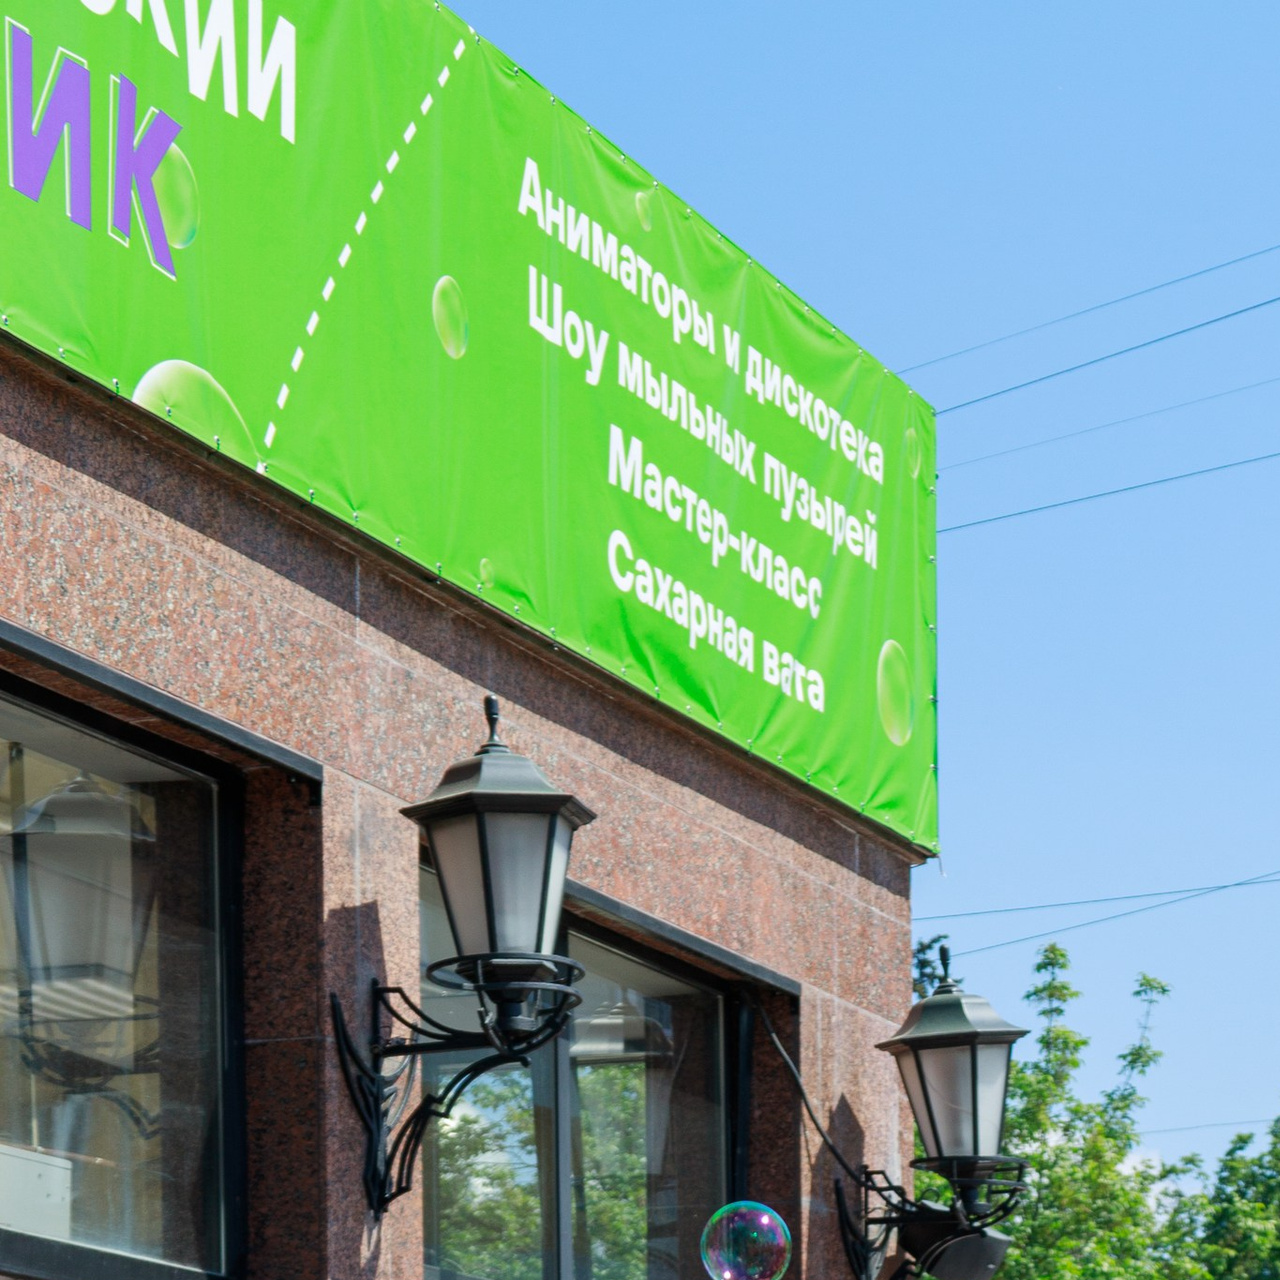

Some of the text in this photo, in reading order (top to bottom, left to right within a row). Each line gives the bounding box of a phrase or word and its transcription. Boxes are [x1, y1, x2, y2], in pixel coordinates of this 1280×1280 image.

[518, 157, 883, 485] Аниматоры и дискотека
[529, 264, 877, 570] Шоу мыльных пузырей
[608, 423, 822, 619] Мастер-класс
[608, 530, 824, 713] Сахарная вата
